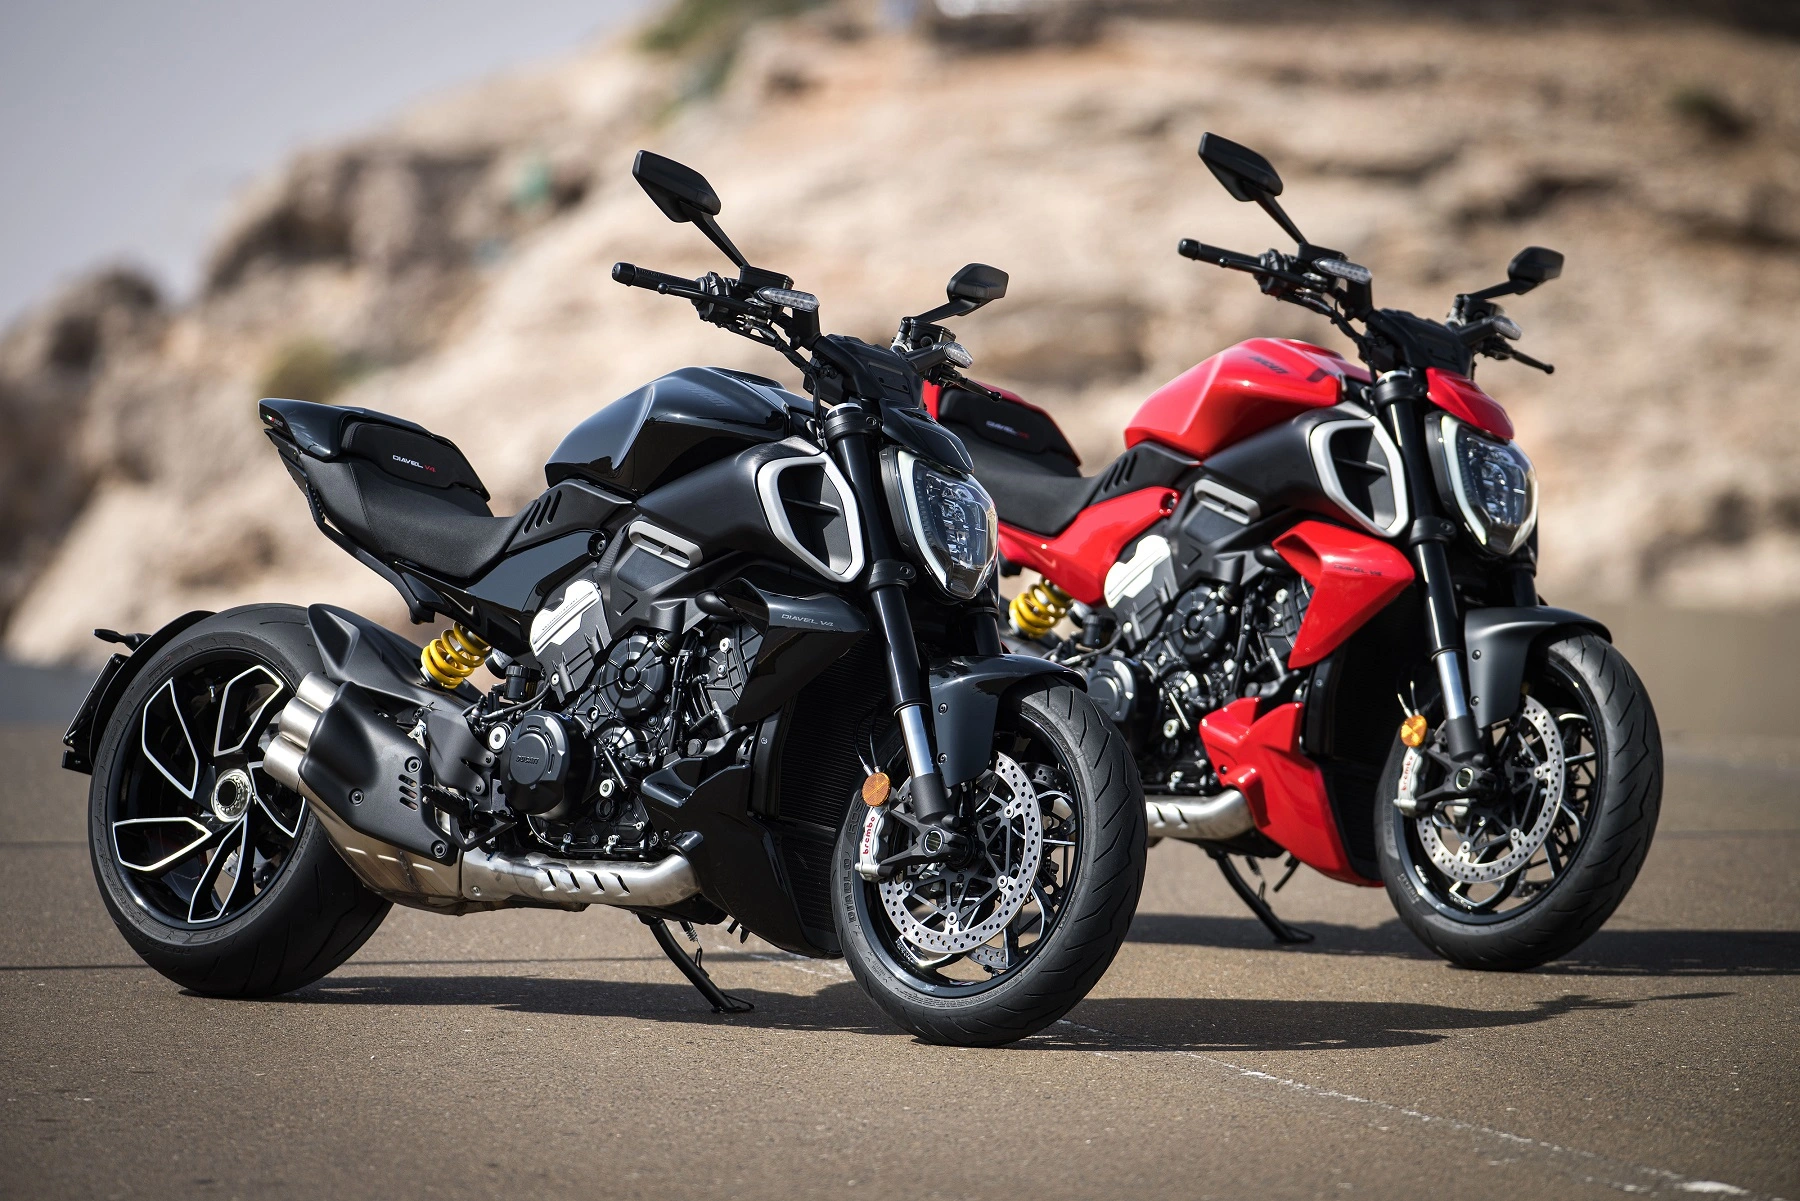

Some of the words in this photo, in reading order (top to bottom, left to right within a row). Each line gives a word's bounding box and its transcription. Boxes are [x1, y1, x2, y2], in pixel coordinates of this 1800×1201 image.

[392, 454, 424, 469] DIAVEL
[424, 464, 437, 473] V4
[781, 613, 819, 625] DIAVEL
[863, 816, 876, 855] brembo
